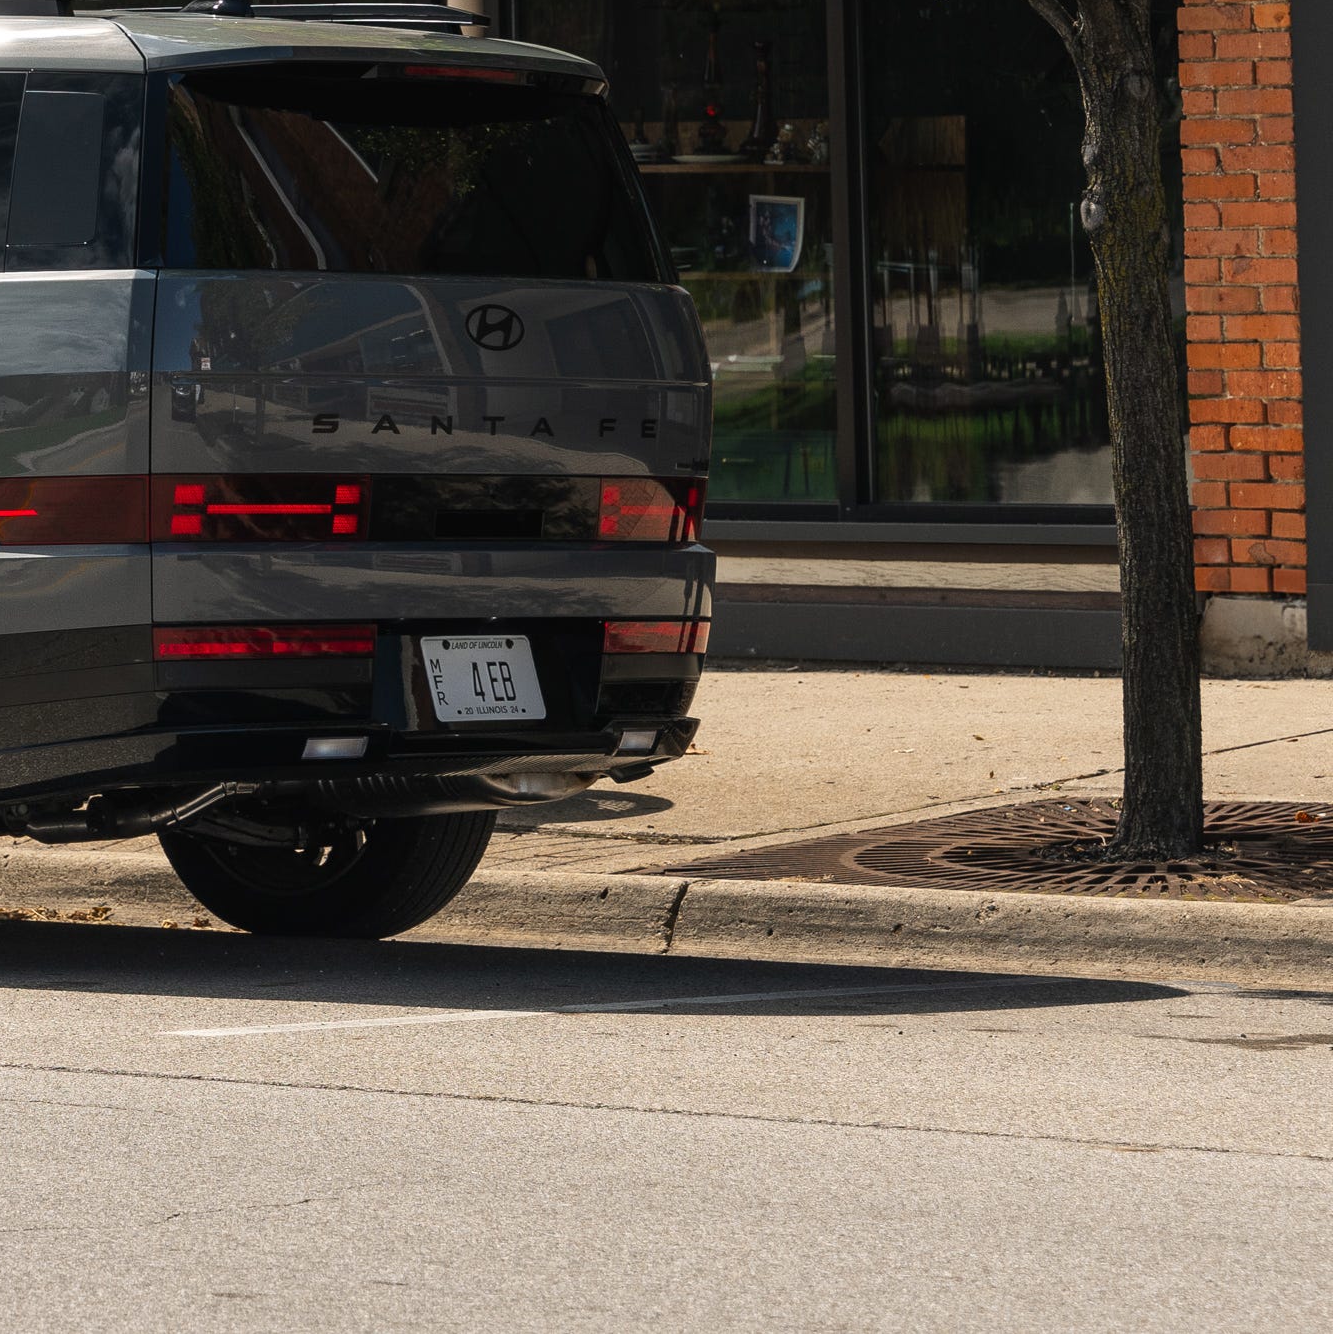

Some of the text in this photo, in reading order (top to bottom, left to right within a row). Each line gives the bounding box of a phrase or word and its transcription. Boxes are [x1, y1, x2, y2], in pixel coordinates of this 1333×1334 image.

[312, 413, 658, 438] SANTA FE
[451, 641, 503, 650] LAND OF LINCOLN
[429, 658, 449, 706] MFR
[471, 661, 517, 702] 4 EB
[465, 705, 519, 715] 20 ILLINOIS 24
